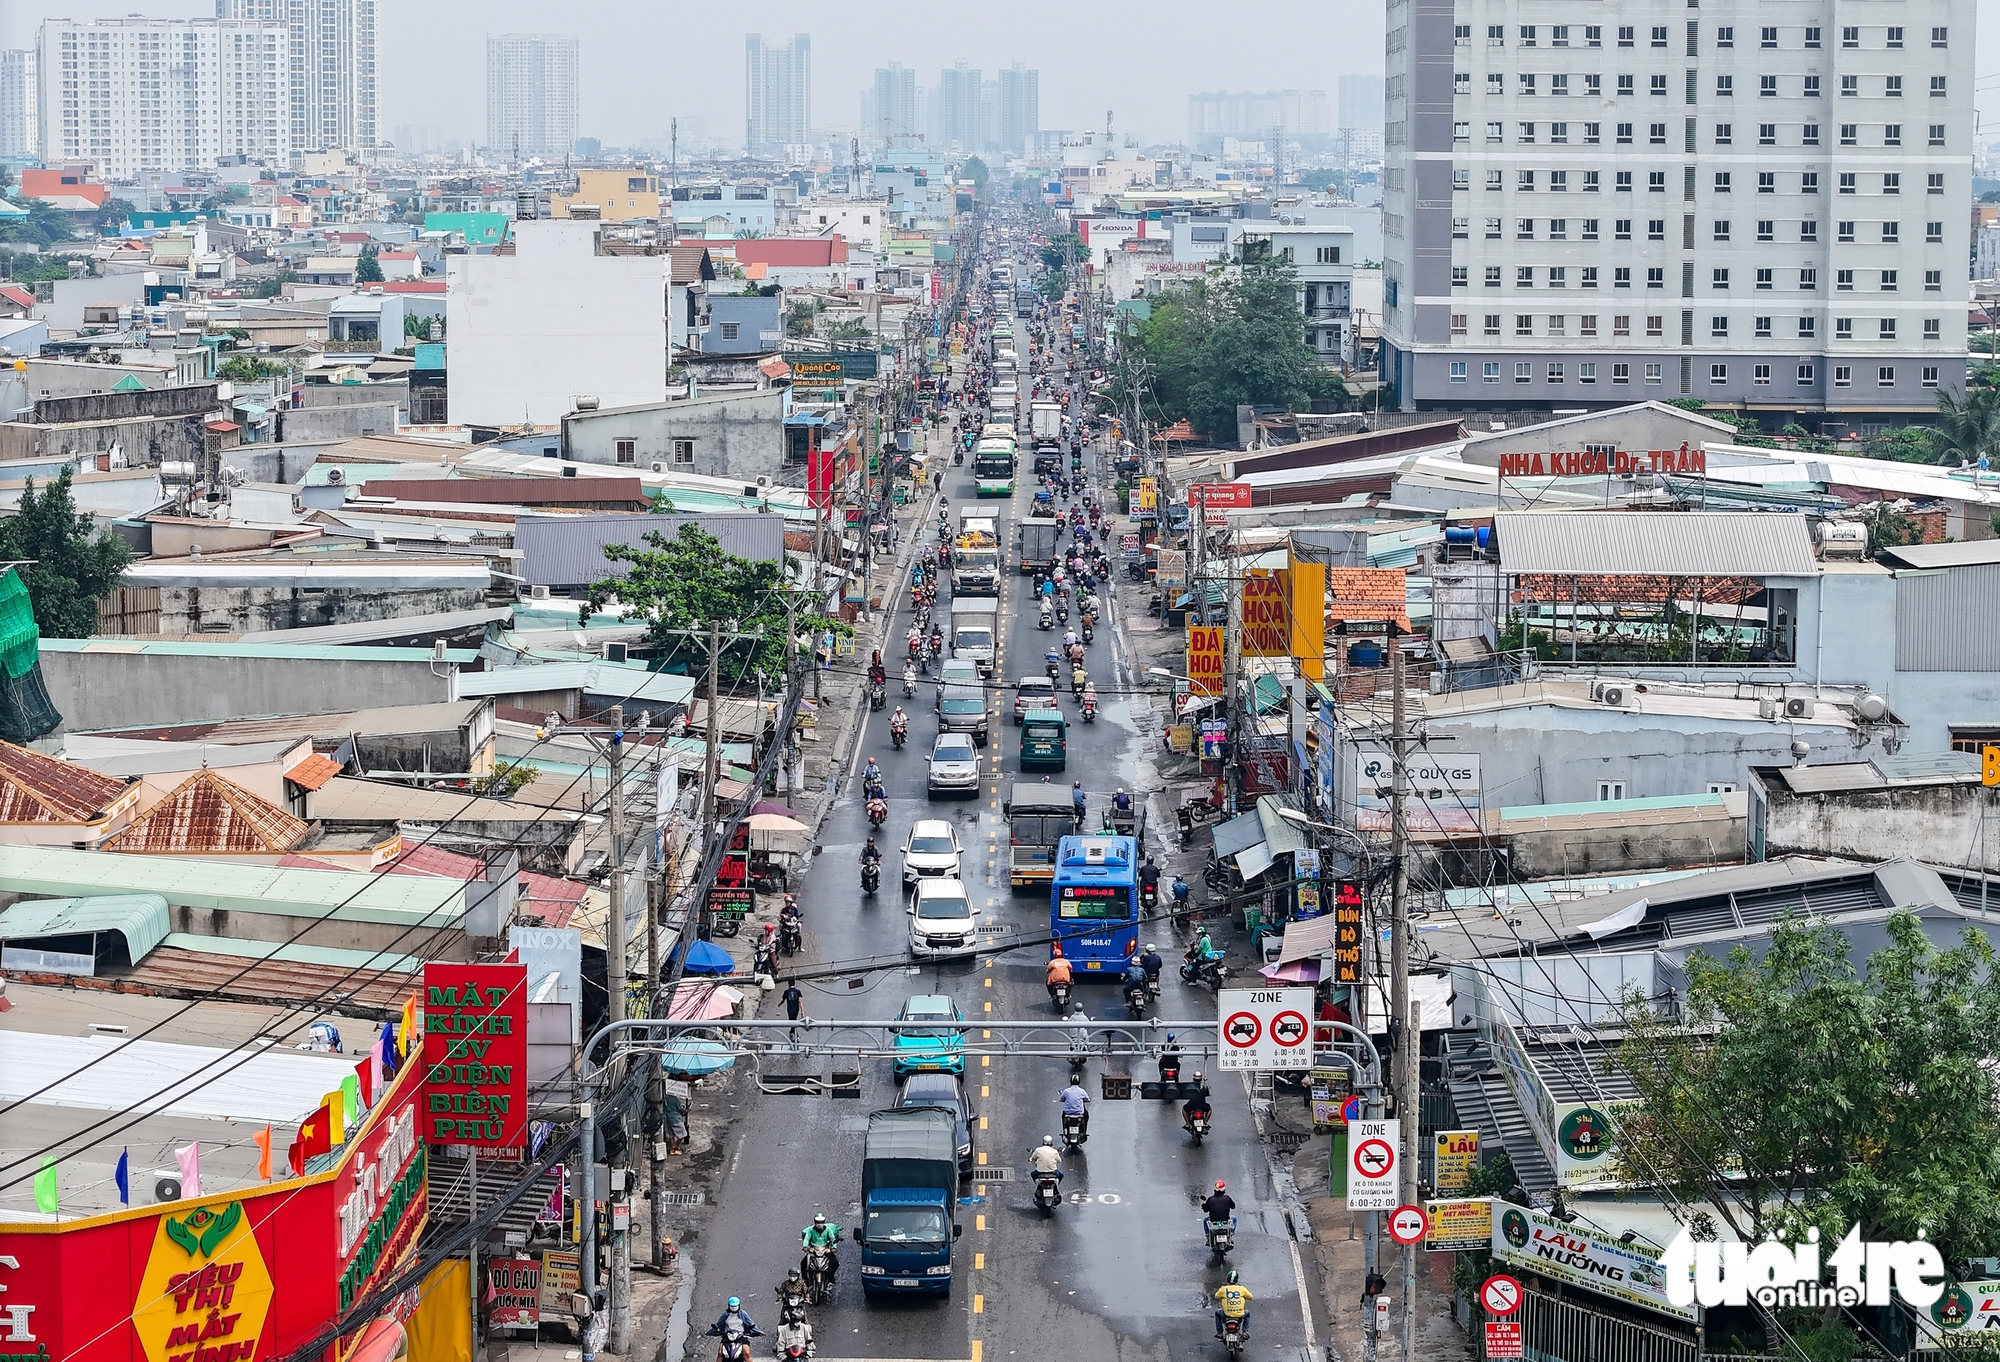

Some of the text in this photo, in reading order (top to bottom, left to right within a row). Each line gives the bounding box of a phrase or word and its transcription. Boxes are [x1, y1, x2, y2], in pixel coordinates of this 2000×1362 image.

[1500, 440, 1706, 476] NHA KHOA Dr. TRẦN
[1244, 600, 1284, 623] HOA
[1192, 628, 1220, 652] ĐÁ
[1190, 654, 1222, 673] HOA
[1451, 769, 1472, 780] GS
[1338, 906, 1359, 922] BÚN
[518, 931, 574, 950] INOX
[1341, 926, 1356, 942] BÒ
[1341, 964, 1355, 980] ĐÁ
[1250, 992, 1282, 1003] ZONE
[425, 1008, 512, 1035] KÍNH
[446, 1039, 492, 1059] BV
[428, 1060, 513, 1088] ĐIỆN
[428, 1090, 511, 1114] BIÊN
[434, 1113, 504, 1140] PHỦ
[1361, 1124, 1386, 1135] ZONE
[1533, 1228, 1587, 1253] LẨU
[1570, 1226, 1590, 1238] VIEW
[1537, 1244, 1624, 1281] NƯỚNG
[164, 1262, 244, 1294] SIÊU
[514, 1265, 538, 1290] CÂU
[174, 1284, 235, 1314] THỊ
[519, 1292, 536, 1309] MÍA
[1226, 1288, 1240, 1299] be
[165, 1308, 242, 1349] MẮT
